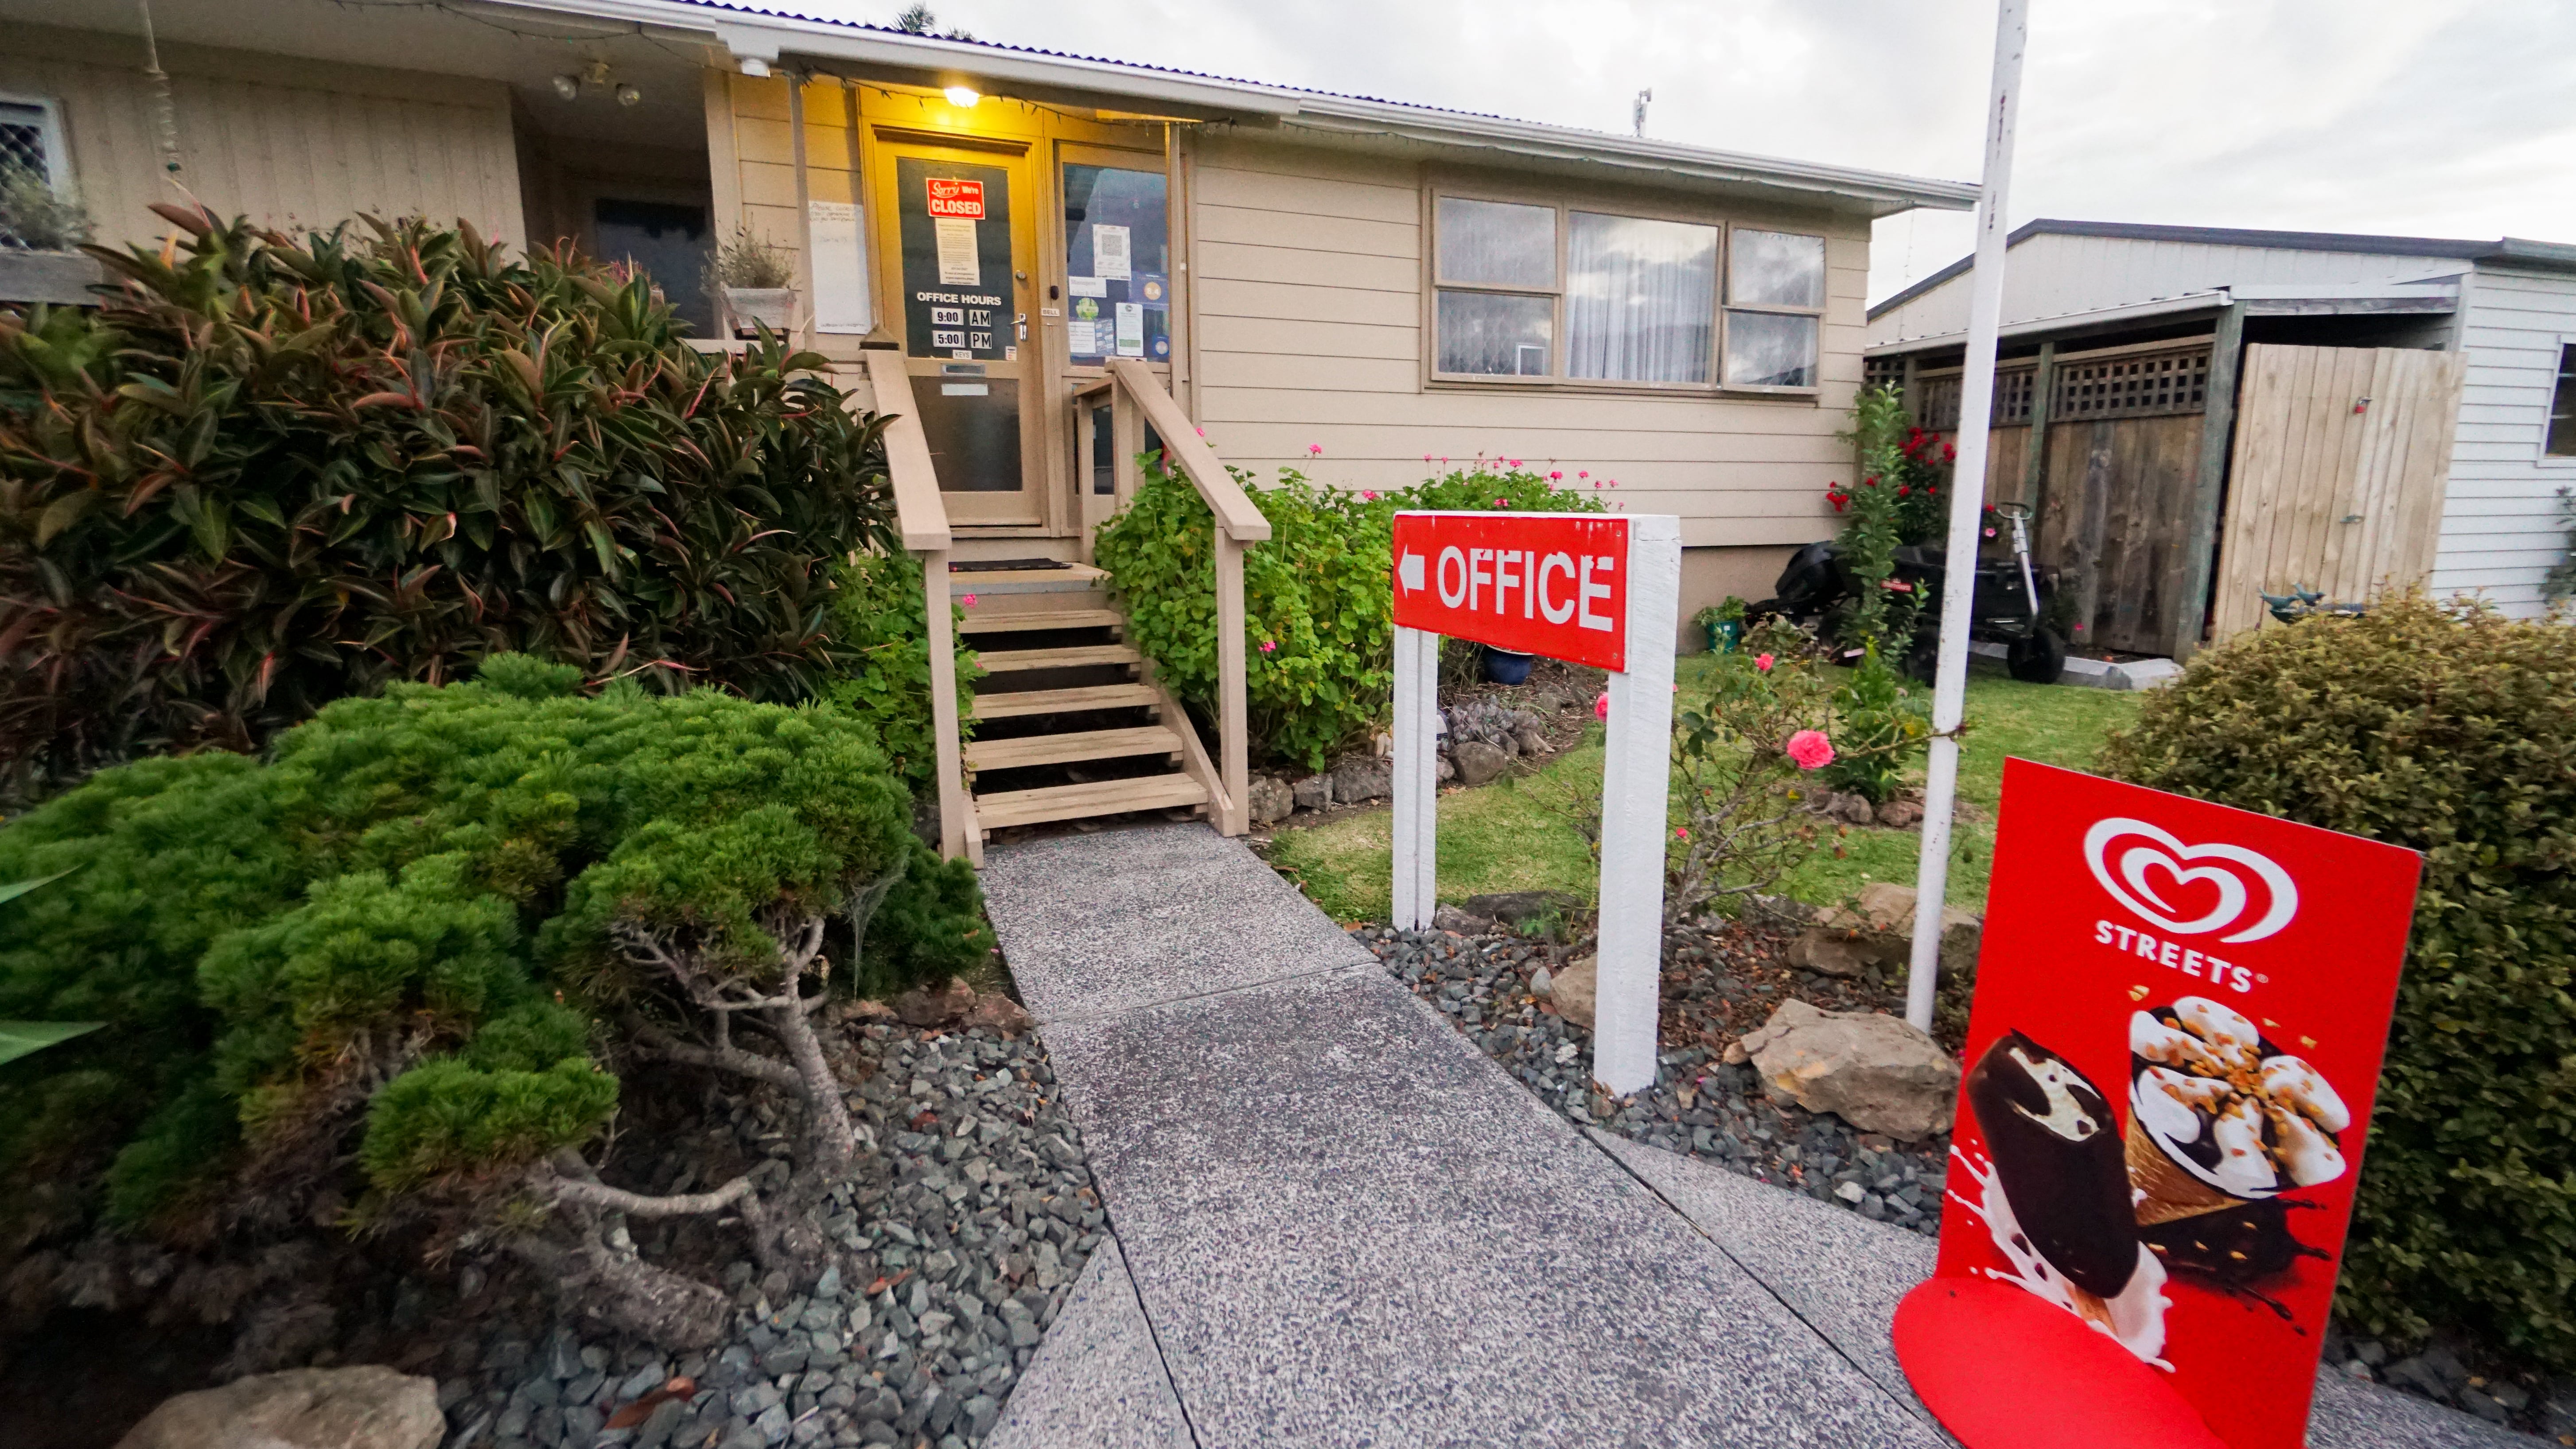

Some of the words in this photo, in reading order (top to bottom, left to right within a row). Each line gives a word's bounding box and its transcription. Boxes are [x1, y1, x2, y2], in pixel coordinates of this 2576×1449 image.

[931, 182, 960, 197] Sorry
[962, 186, 979, 194] We're
[931, 199, 981, 215] CLOSED
[917, 292, 958, 303] OFFICE
[961, 294, 1002, 306] HOURS
[938, 311, 958, 322] 9:00
[972, 311, 990, 325] AM
[938, 334, 959, 344] 5:00
[973, 334, 992, 348] PM
[1437, 545, 1614, 632] OFFICE
